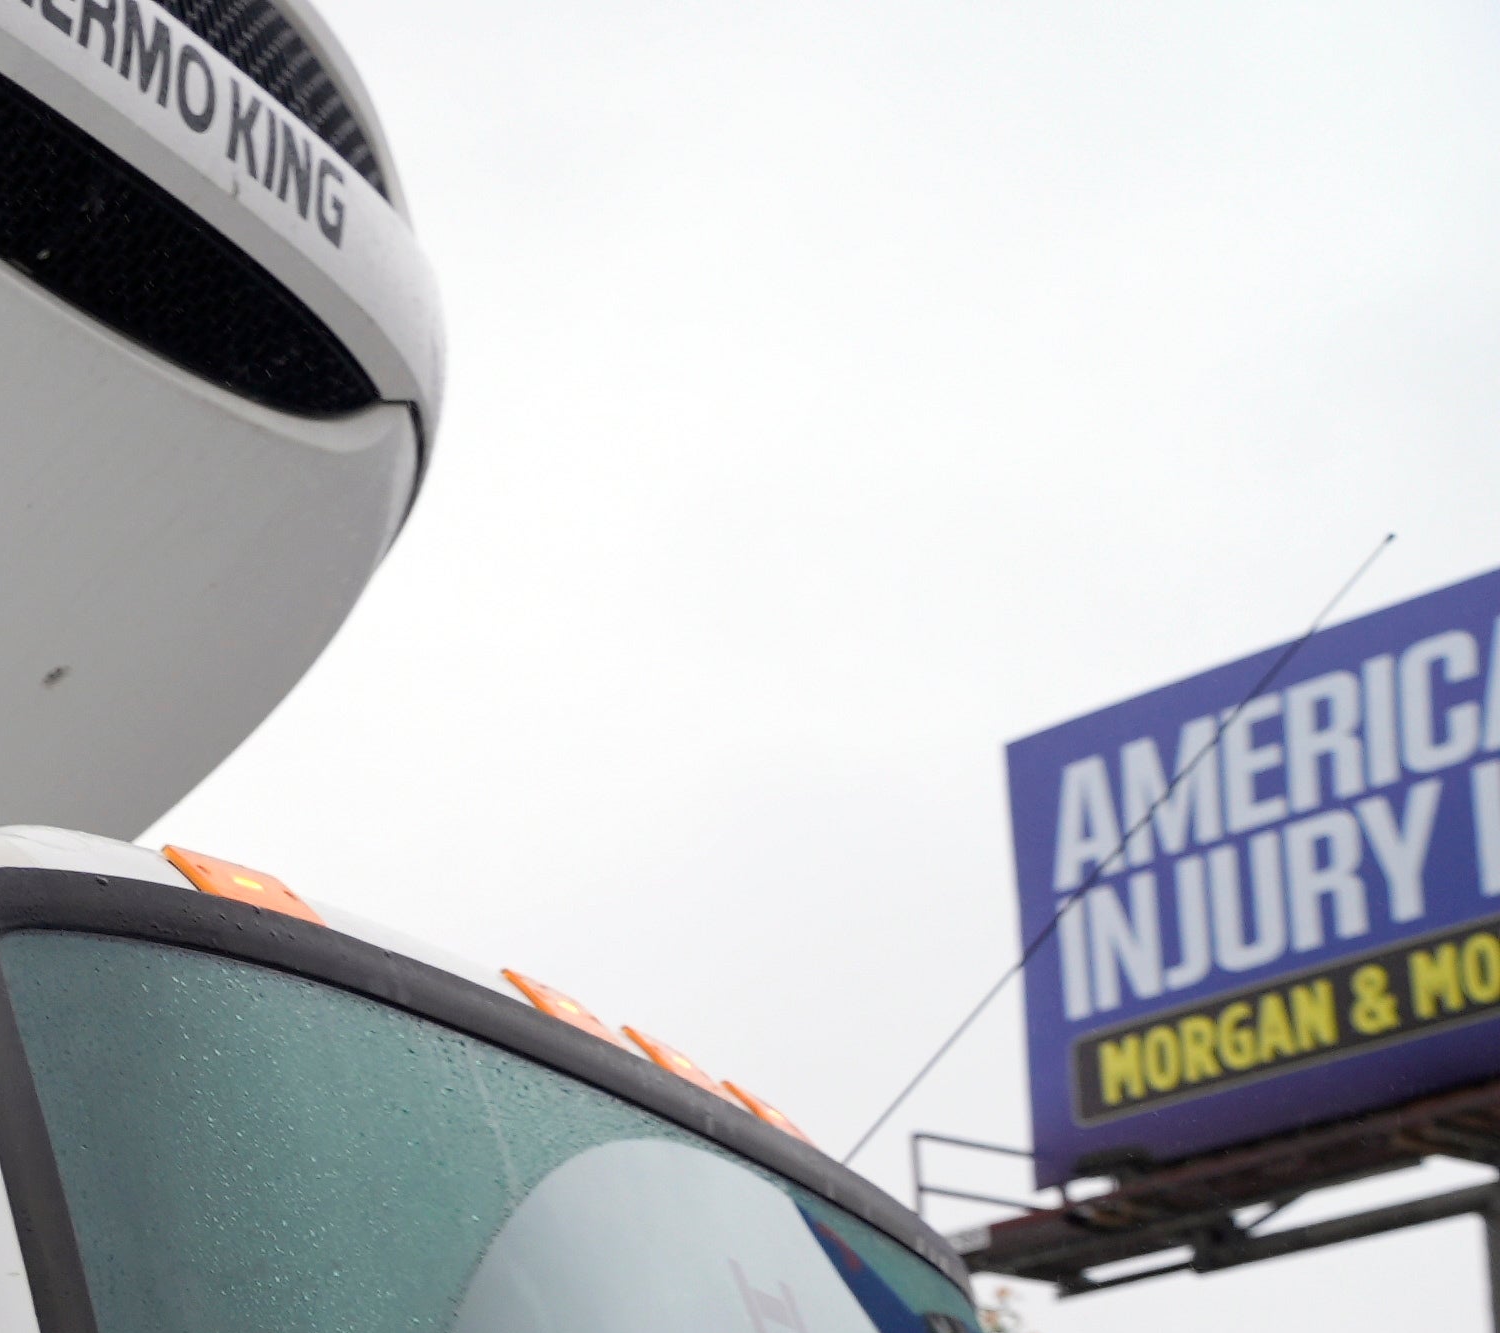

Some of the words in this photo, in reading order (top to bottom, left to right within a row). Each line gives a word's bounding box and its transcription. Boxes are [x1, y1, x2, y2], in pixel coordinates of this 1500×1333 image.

[227, 76, 347, 249] KING
[1054, 616, 1500, 893] AMERIC
[1055, 778, 1443, 1021] INJURY
[1098, 977, 1340, 1104] MORGAN
[1350, 963, 1401, 1035] &
